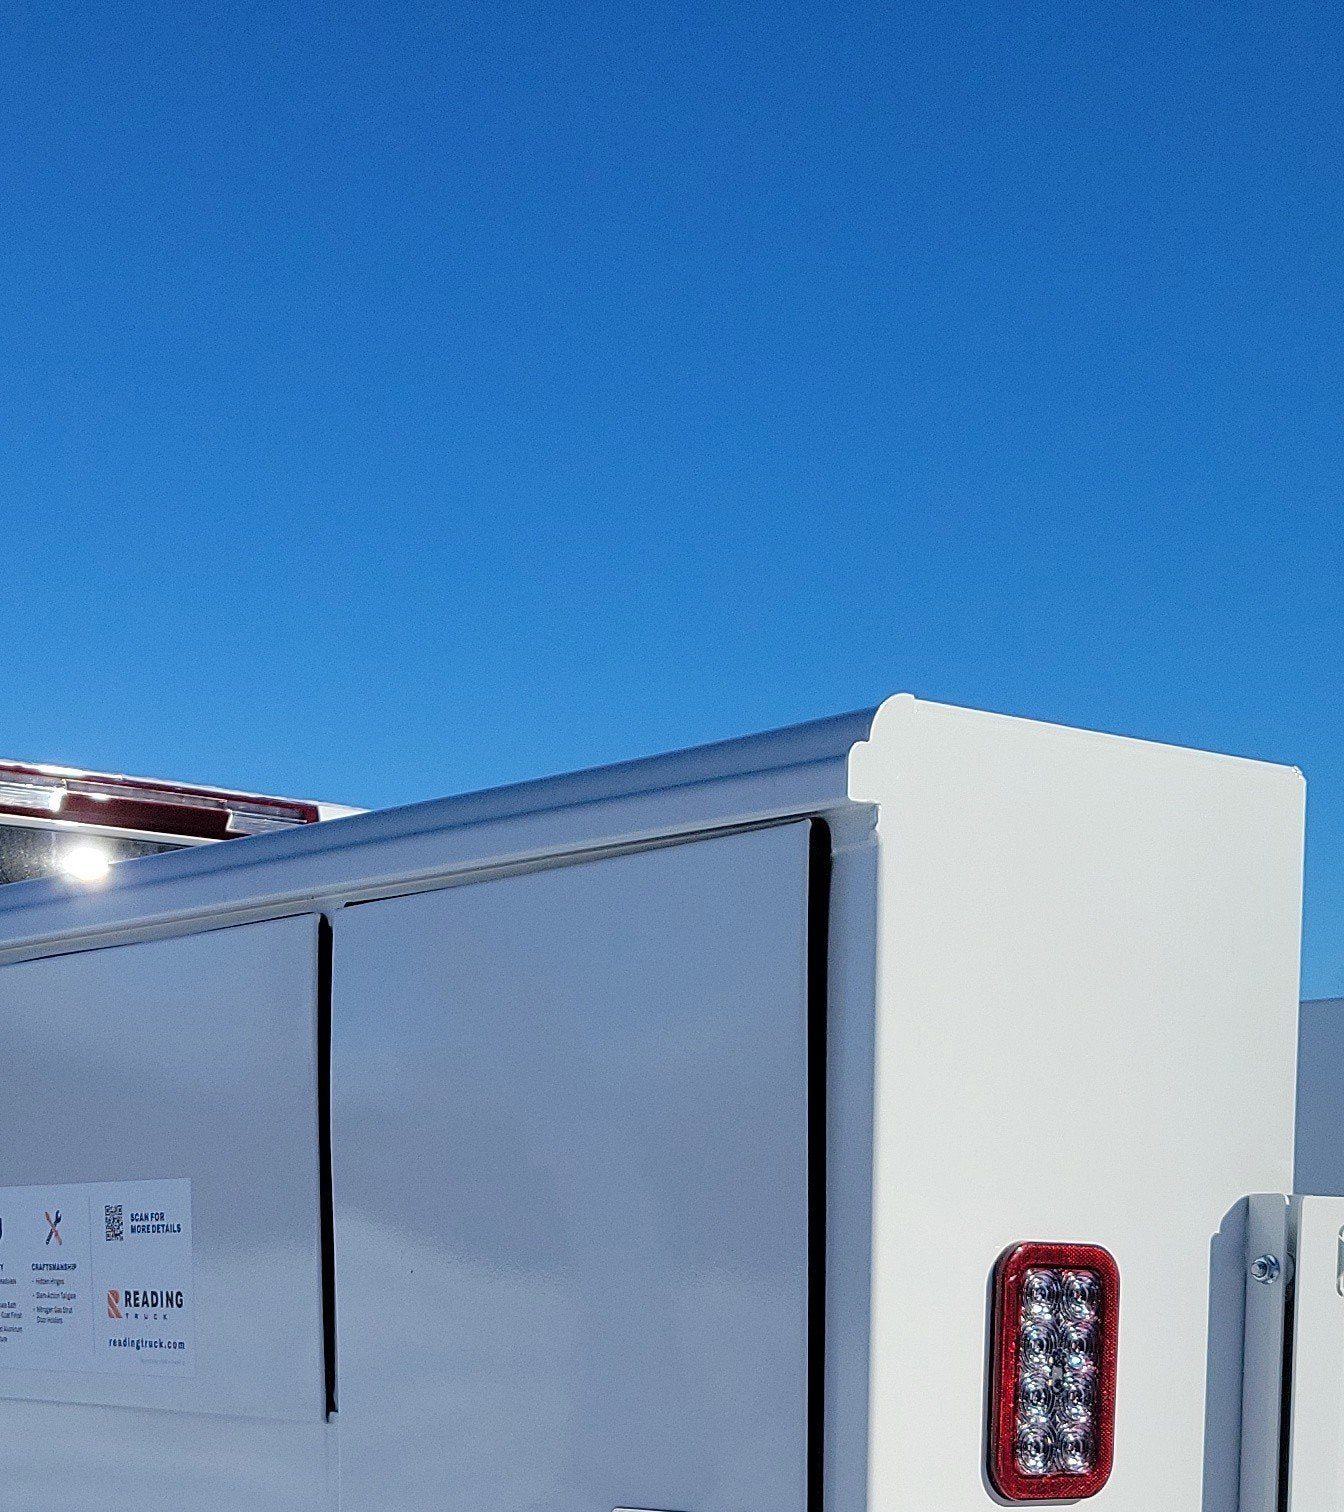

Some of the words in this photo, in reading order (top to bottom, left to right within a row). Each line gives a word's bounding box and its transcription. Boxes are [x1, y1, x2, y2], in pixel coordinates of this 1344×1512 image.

[130, 1212, 149, 1222] SCAN
[150, 1212, 165, 1221] FOR
[130, 1224, 151, 1234] MORE
[151, 1223, 182, 1234] DETAILS
[124, 1290, 184, 1308] READING
[109, 1337, 186, 1350] readingtruck.com
